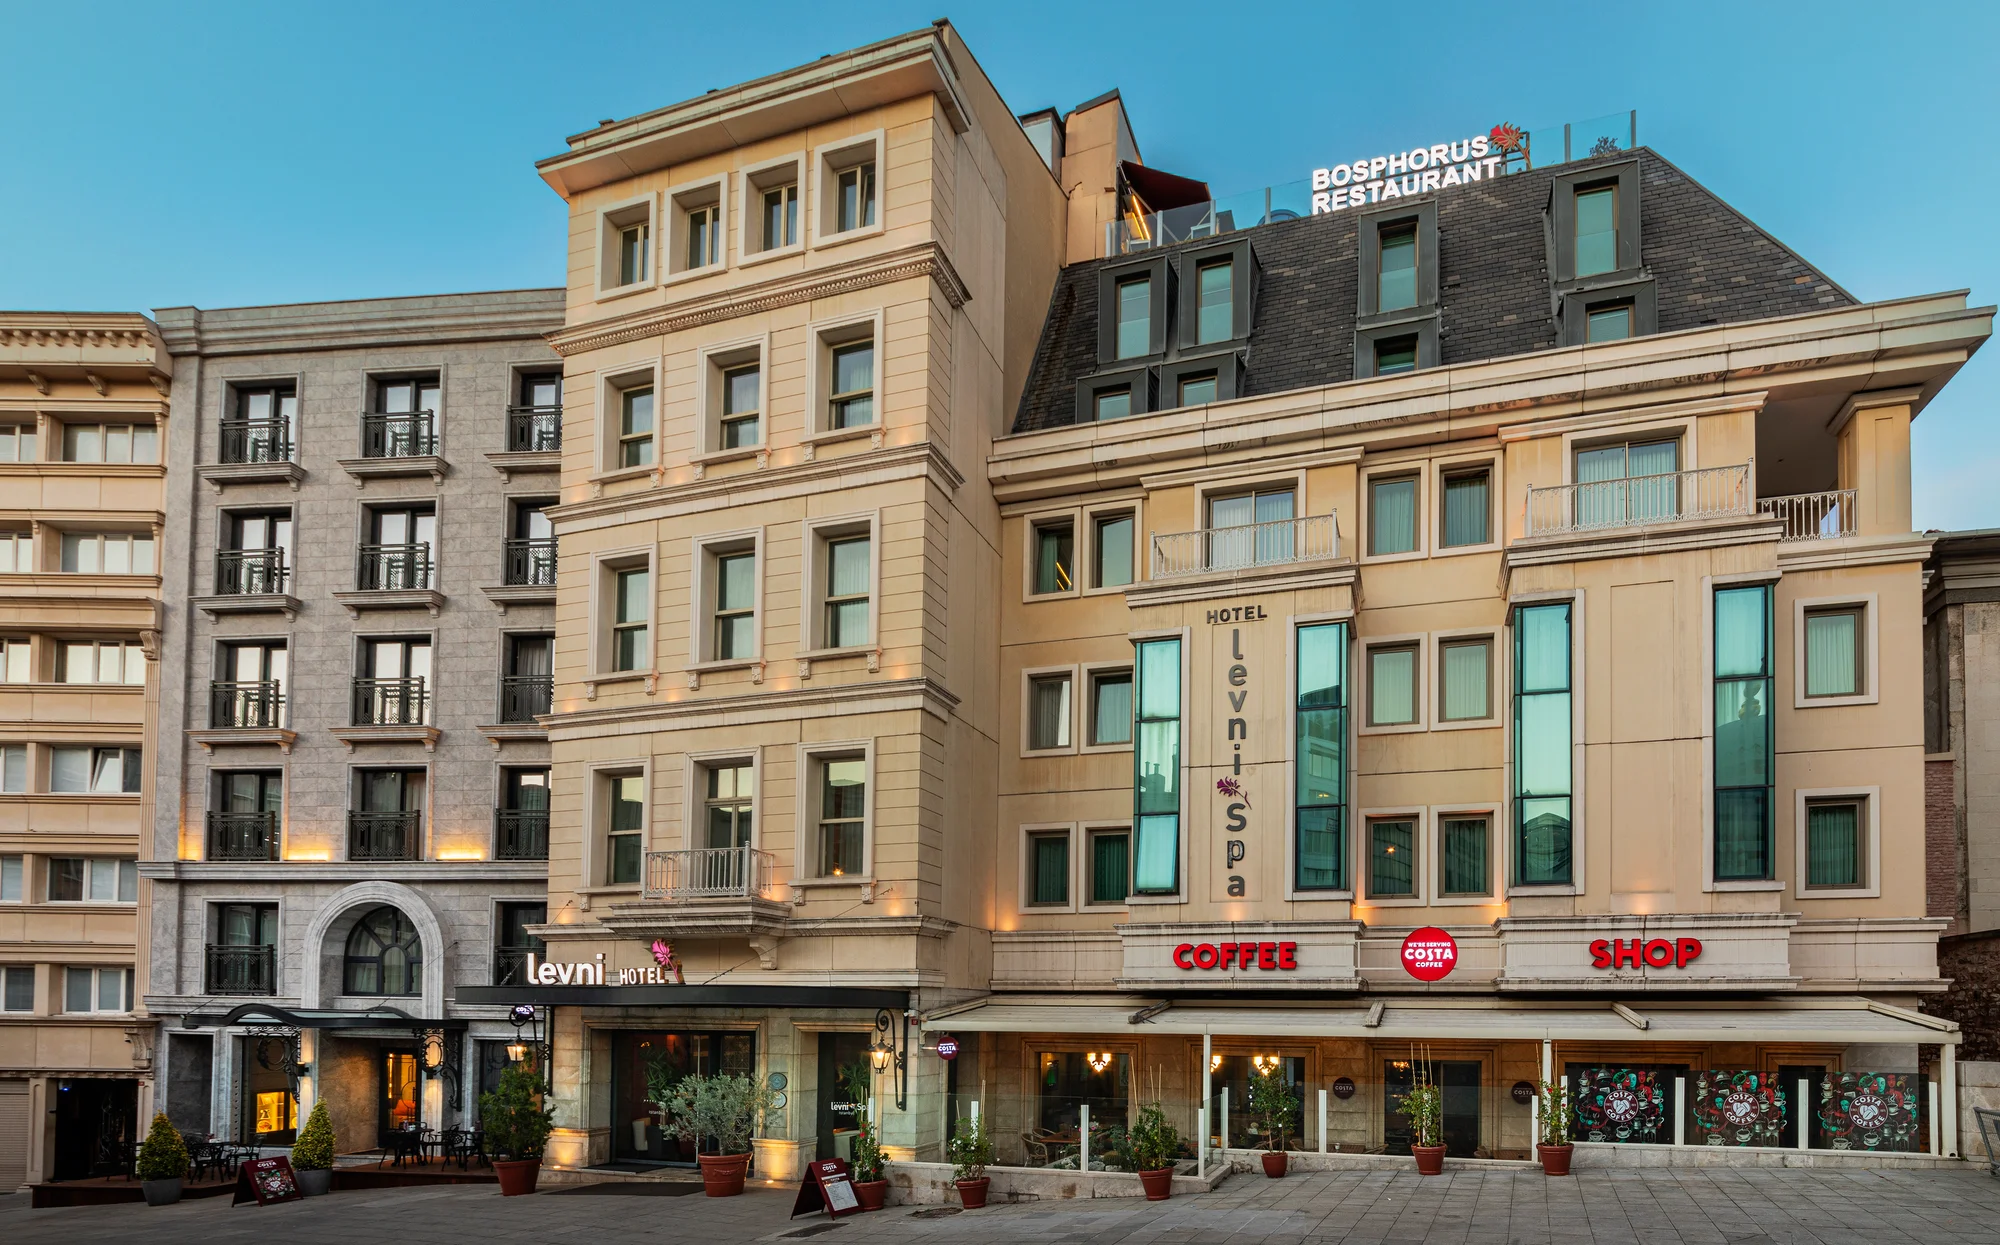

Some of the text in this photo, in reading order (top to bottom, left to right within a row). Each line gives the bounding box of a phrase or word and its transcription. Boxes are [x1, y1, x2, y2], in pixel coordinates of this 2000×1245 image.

[1313, 136, 1489, 191] BOSPHORUS
[1313, 156, 1501, 215] RESTAURANT
[1207, 605, 1268, 624] HOTEL
[1226, 628, 1248, 897] levni Spa
[1173, 941, 1297, 970] COFFEE
[1404, 948, 1454, 961] COSTA
[1589, 938, 1703, 968] SHOP
[527, 953, 666, 985] levni HOTEL
[1608, 1091, 1633, 1101] COSTA
[1728, 1093, 1754, 1104] COSTA
[1854, 1096, 1882, 1107] COSTA
[830, 1101, 870, 1112] levni Sp
[1606, 1109, 1636, 1121] COFFEE
[1726, 1111, 1757, 1124] COFFEE
[1852, 1114, 1885, 1127] COFFEE
